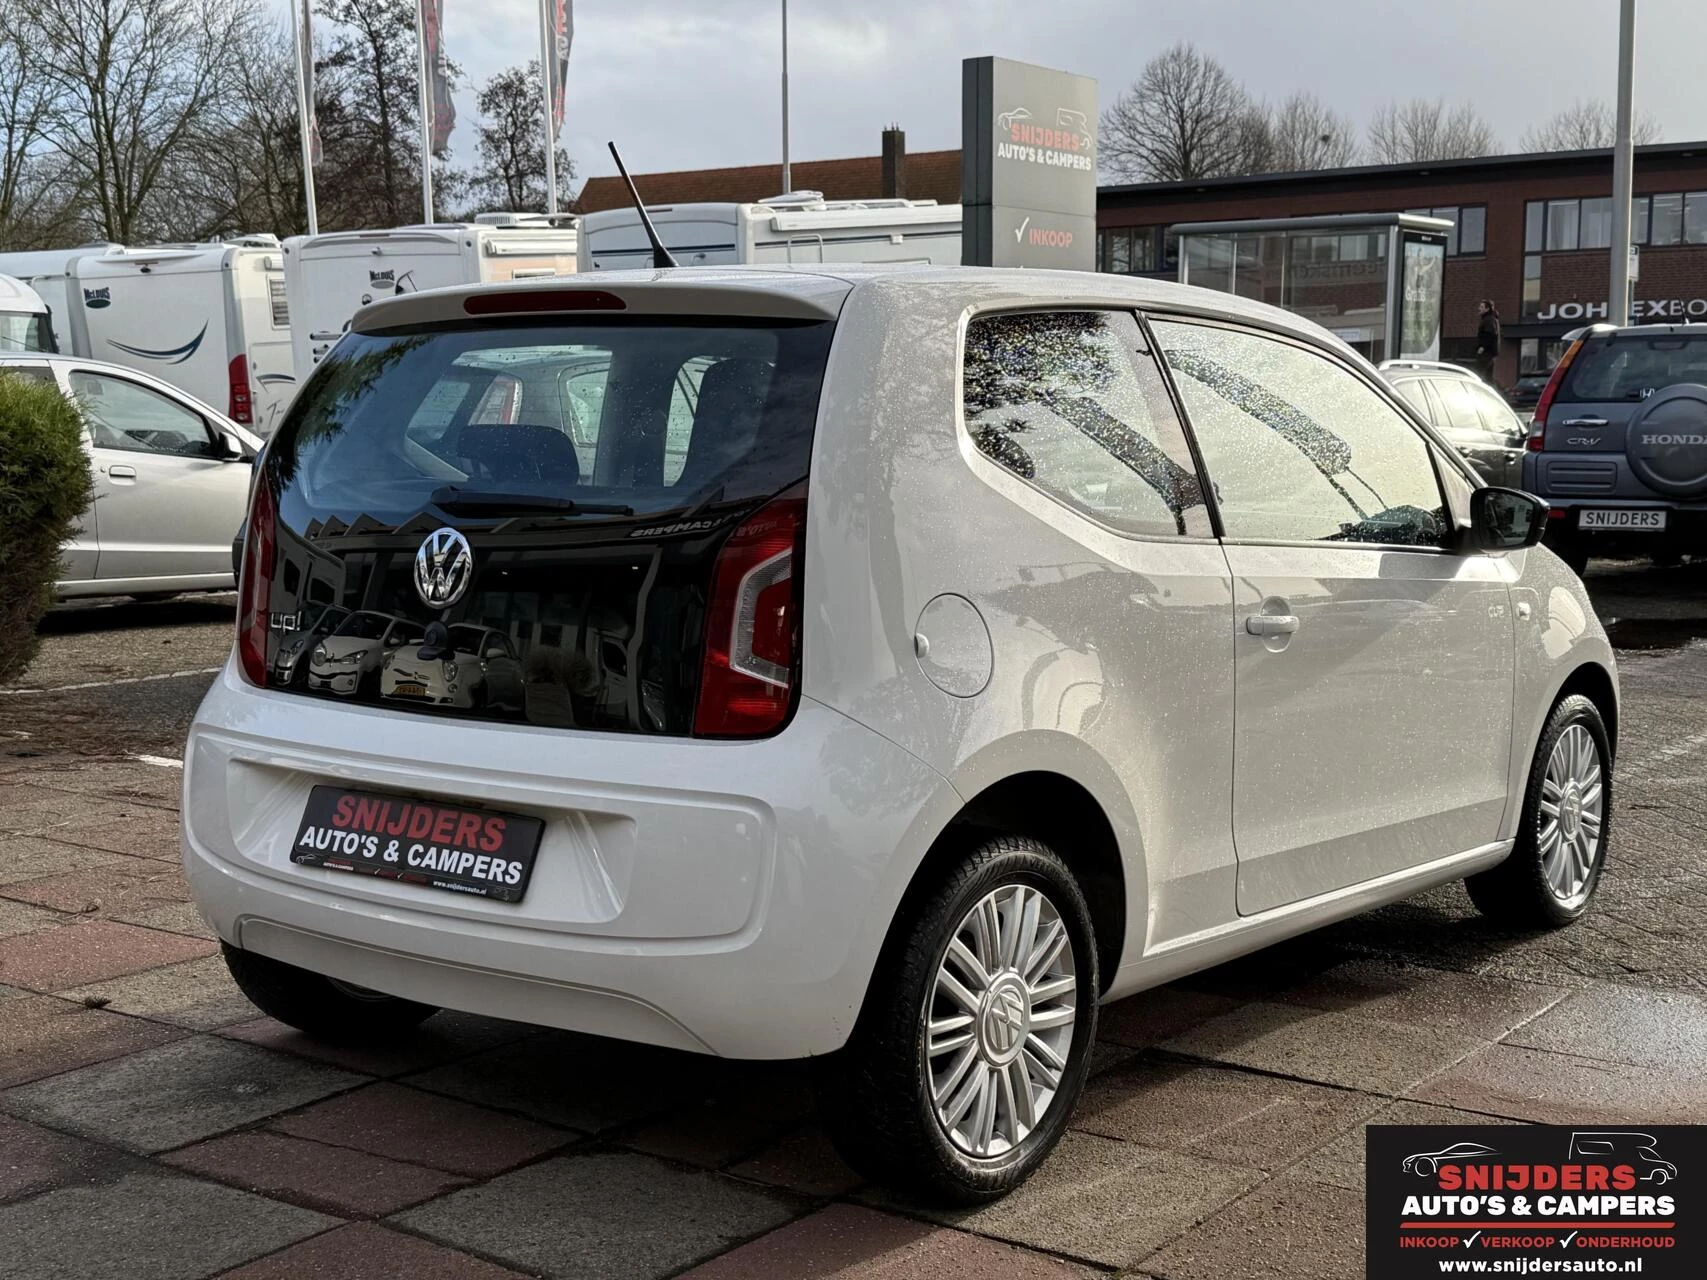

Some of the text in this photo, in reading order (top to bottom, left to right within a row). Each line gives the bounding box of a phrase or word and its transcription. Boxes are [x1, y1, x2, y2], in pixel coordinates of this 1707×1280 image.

[1011, 123, 1081, 151] SNIJDERS
[998, 142, 1092, 171] AUTO'S & CAMPERS
[1029, 229, 1073, 248] INKOOP
[1641, 434, 1707, 445] HOND
[1585, 512, 1660, 526] SNIJDERS
[271, 610, 302, 634] up!
[331, 795, 507, 853] SNIJDERS
[299, 826, 379, 858] AUTO'S
[383, 839, 400, 863] &
[407, 843, 523, 885] CAMPERS
[433, 881, 487, 895] www.snijdersauto.nl
